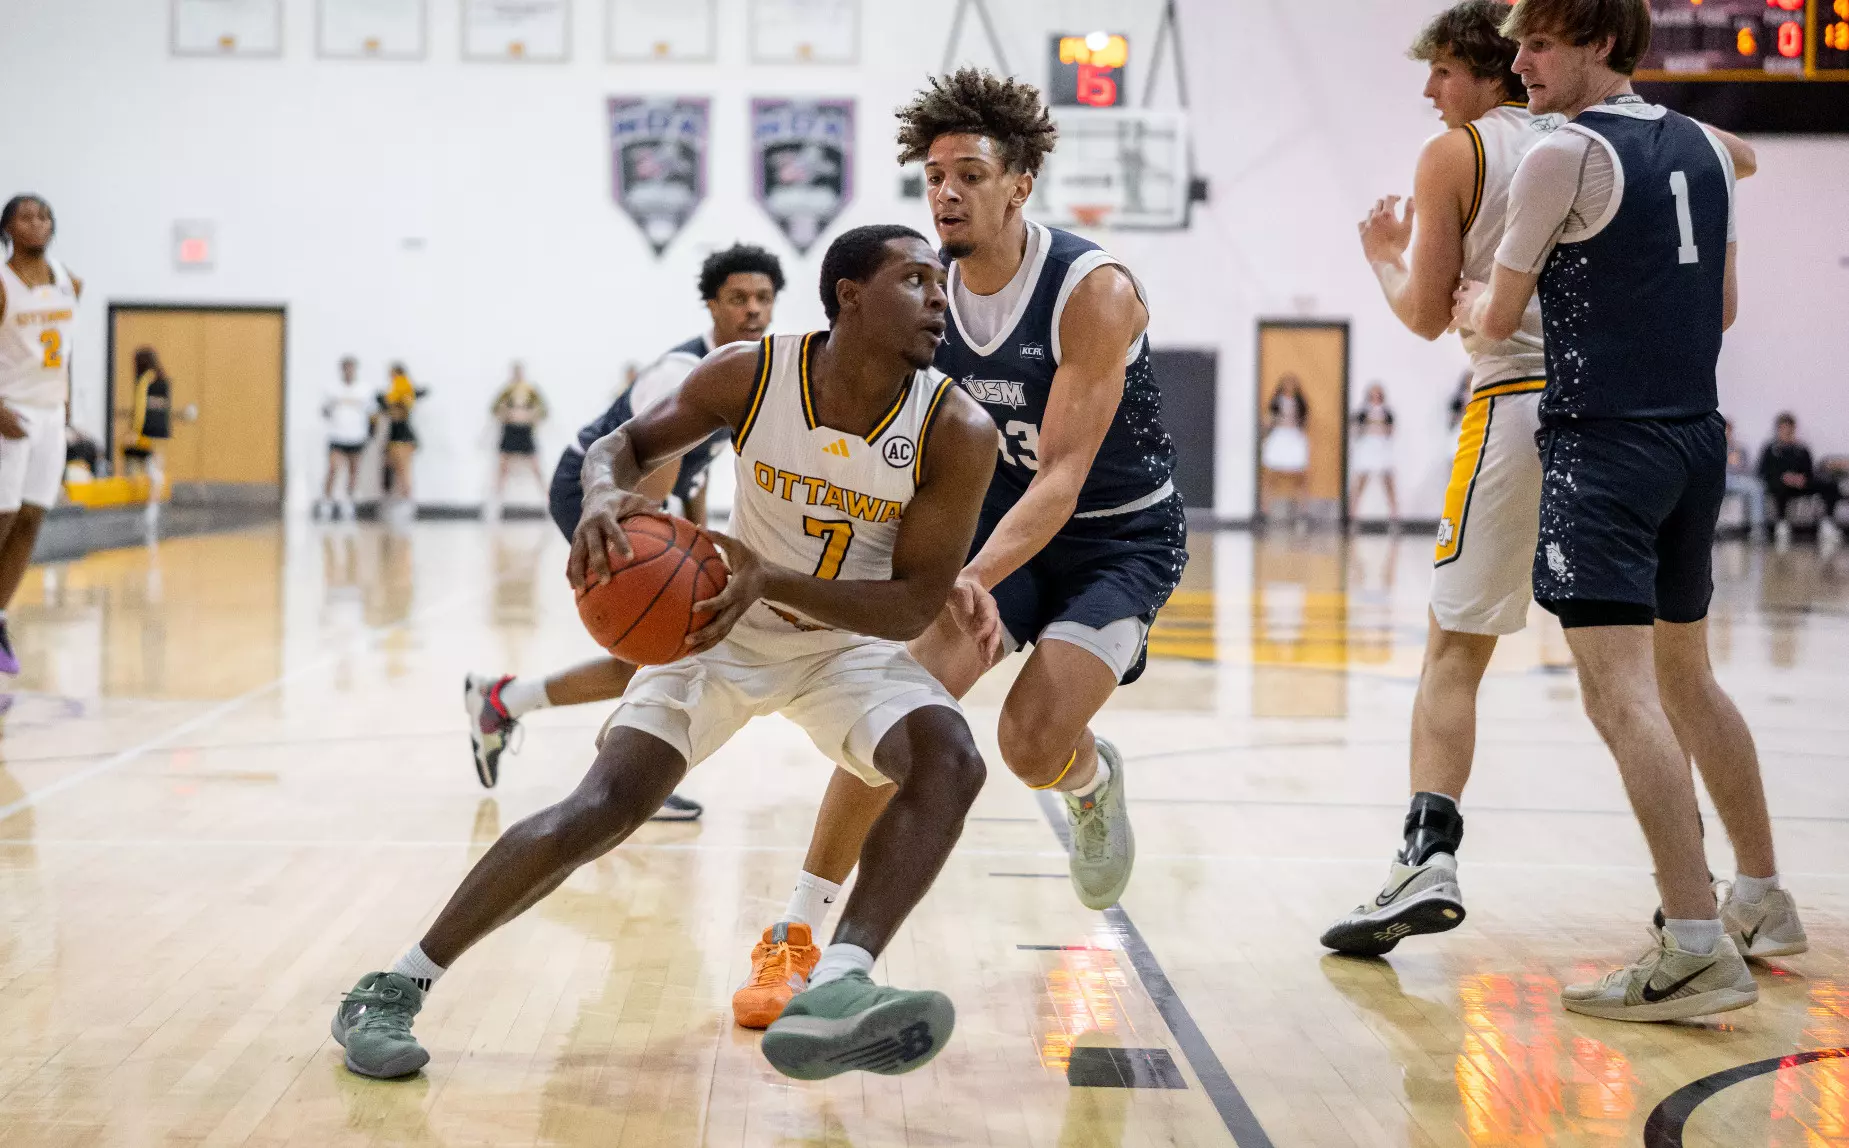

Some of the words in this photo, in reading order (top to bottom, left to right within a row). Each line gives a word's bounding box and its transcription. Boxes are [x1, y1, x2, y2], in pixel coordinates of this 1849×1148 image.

[1778, 20, 1803, 58] 0
[1669, 171, 1699, 264] 1
[40, 328, 62, 369] 2
[964, 378, 1027, 410] USM
[887, 442, 911, 462] AC
[754, 460, 903, 523] OTTAWA
[803, 515, 855, 580] 7
